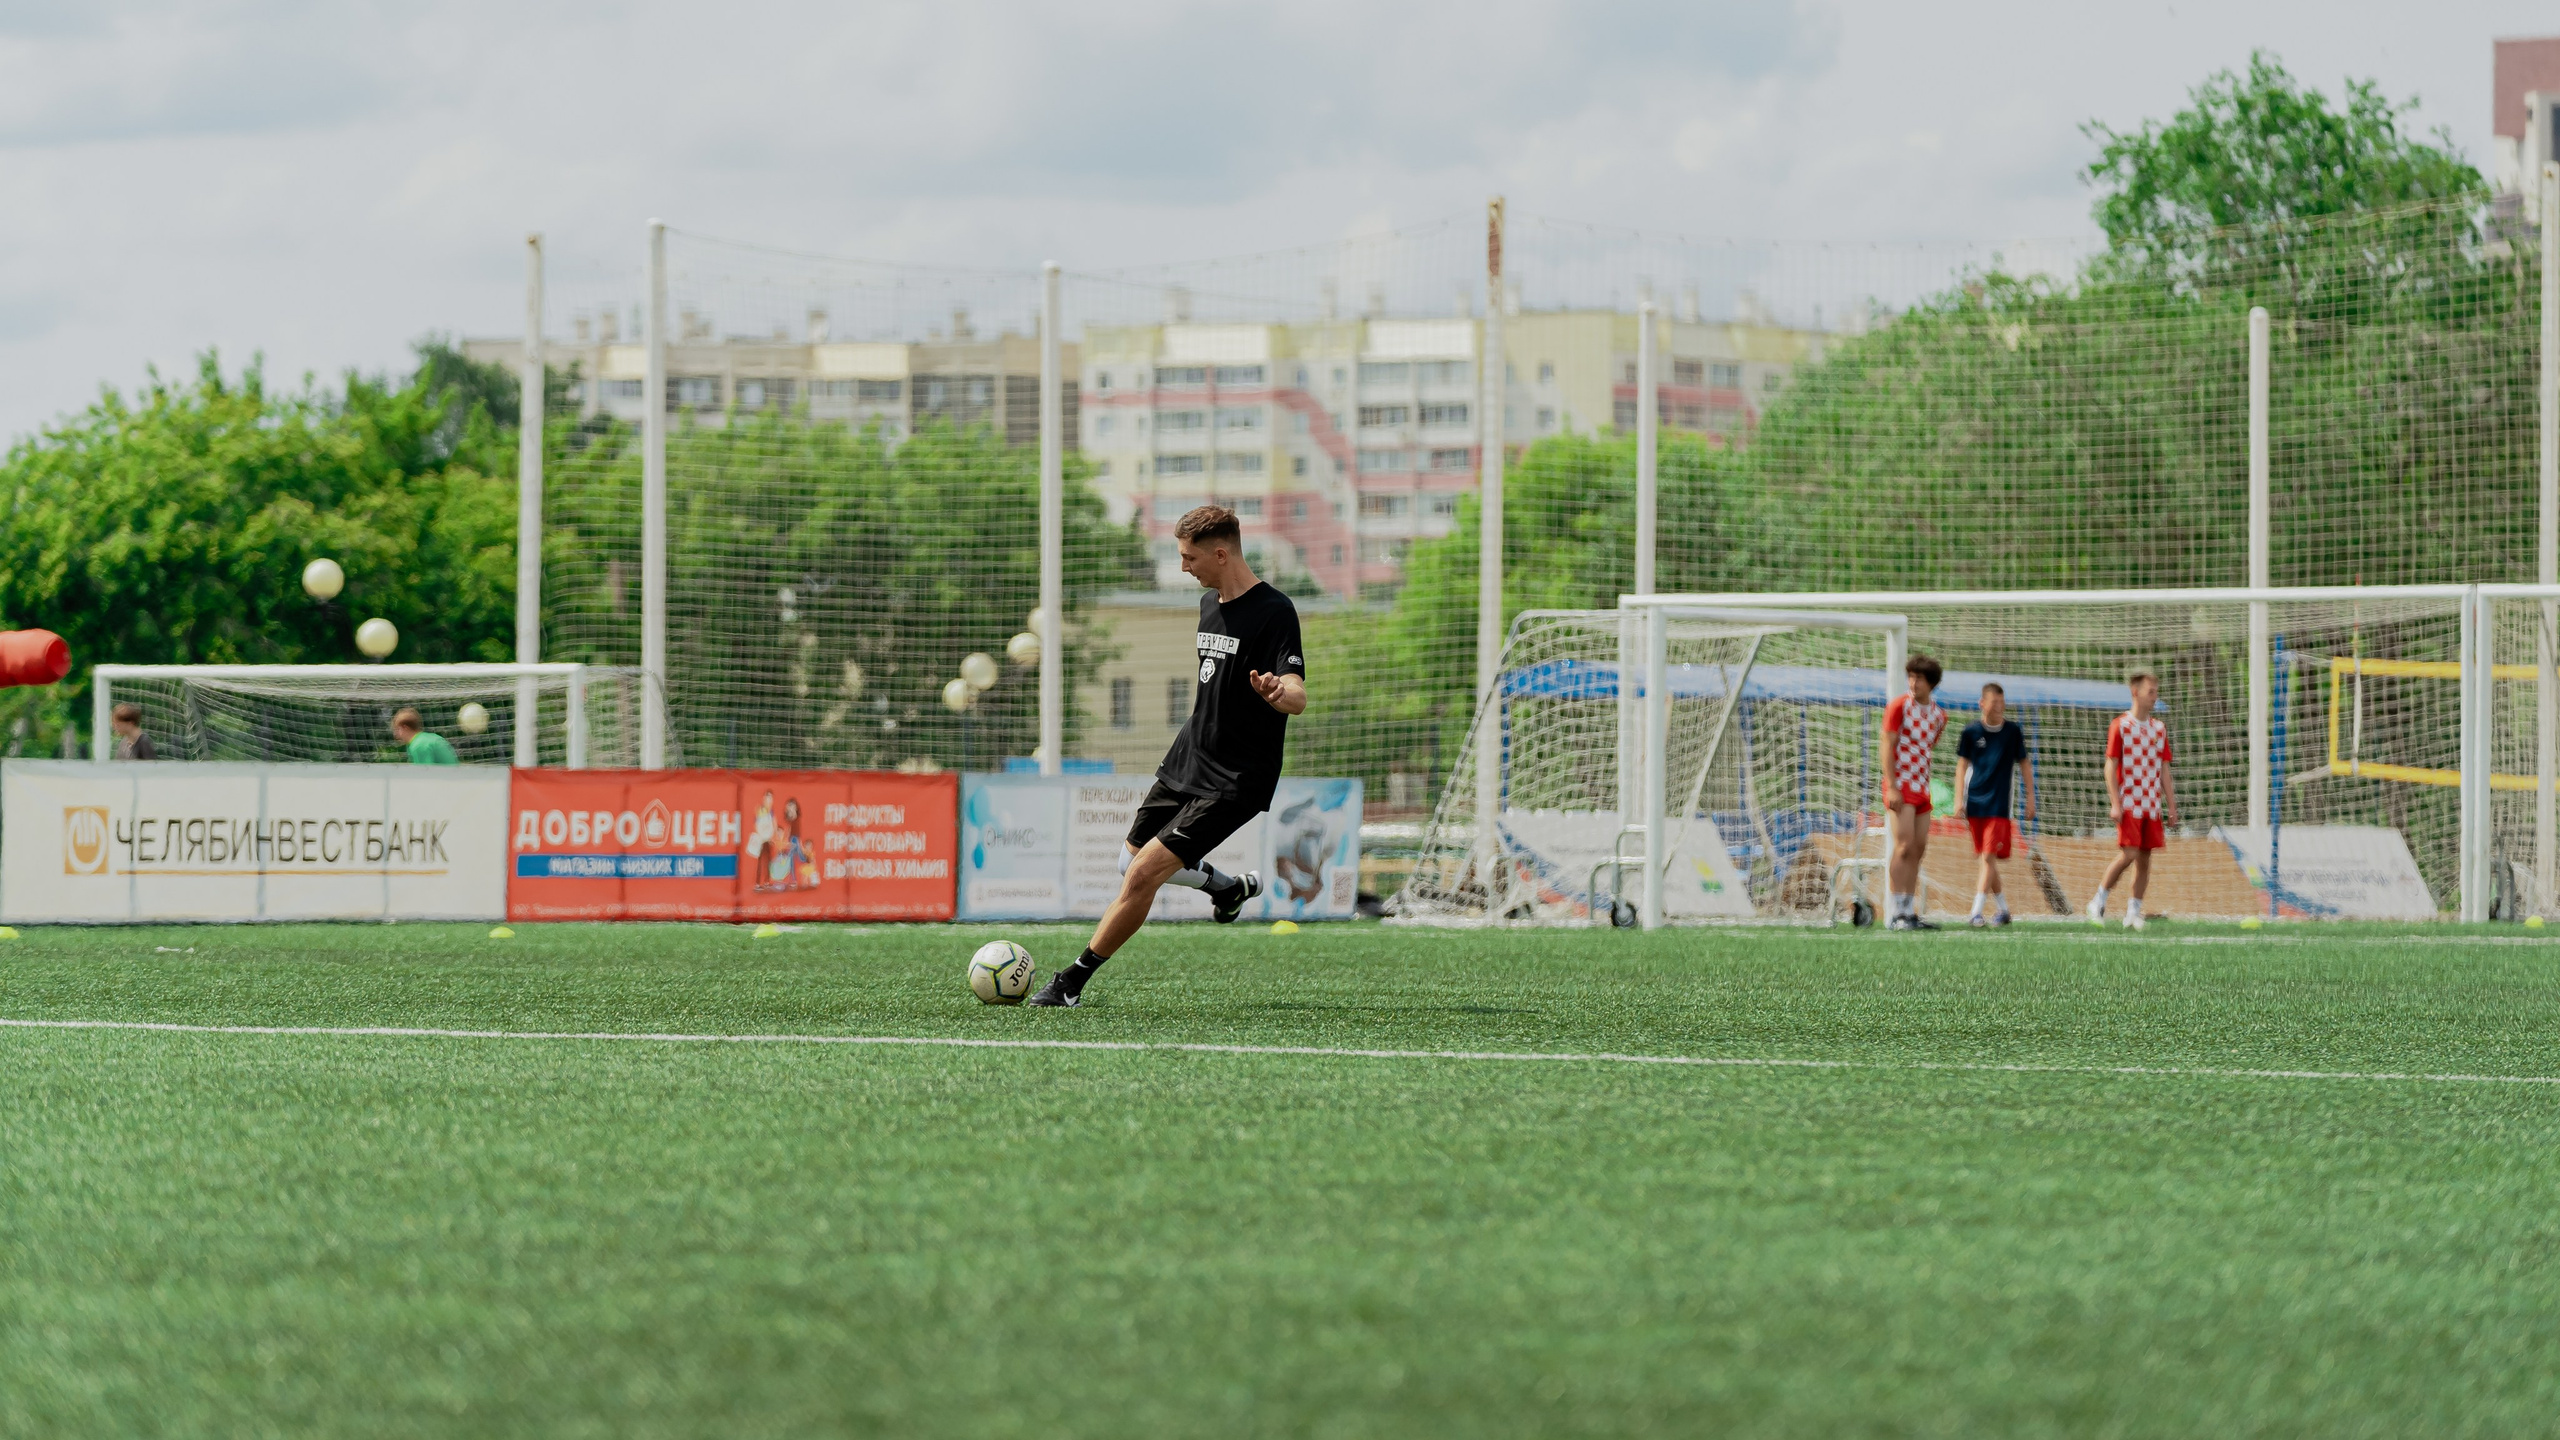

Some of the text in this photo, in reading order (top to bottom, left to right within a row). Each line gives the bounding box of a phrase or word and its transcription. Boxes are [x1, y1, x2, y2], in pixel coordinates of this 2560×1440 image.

[825, 803, 905, 826] ПРОДУКТЫ
[115, 819, 449, 862] ЧЕЛЯБИНВЕСТБАНК
[824, 831, 926, 854] ПРОМТОВАРЫ
[824, 859, 948, 878] БЫТОВАЯ ХИМИЯ
